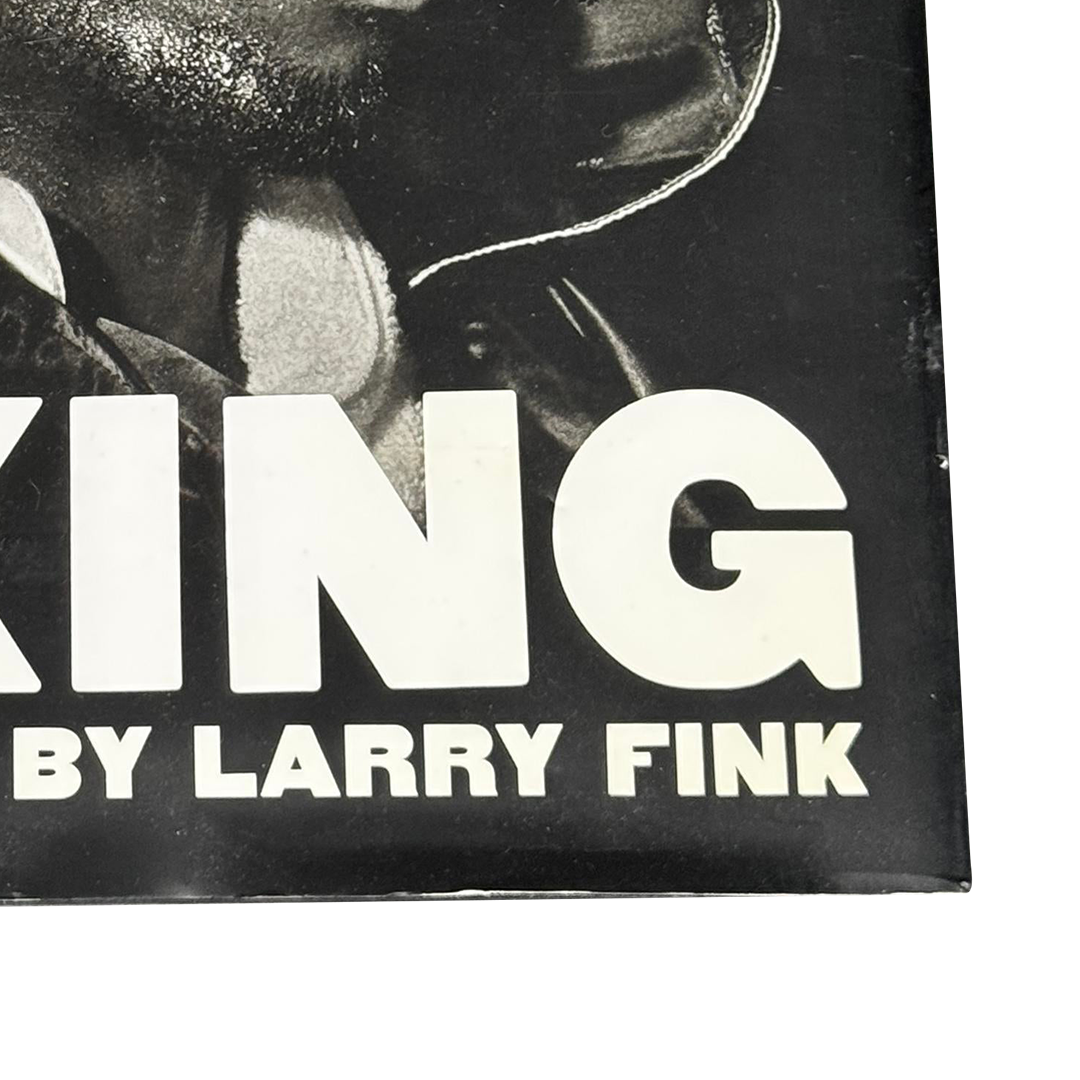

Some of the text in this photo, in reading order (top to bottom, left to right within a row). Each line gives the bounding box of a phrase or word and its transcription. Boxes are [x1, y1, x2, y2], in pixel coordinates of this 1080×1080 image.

[12, 725, 153, 801] BY
[193, 723, 564, 799] LARRY
[605, 721, 870, 798] FINK
